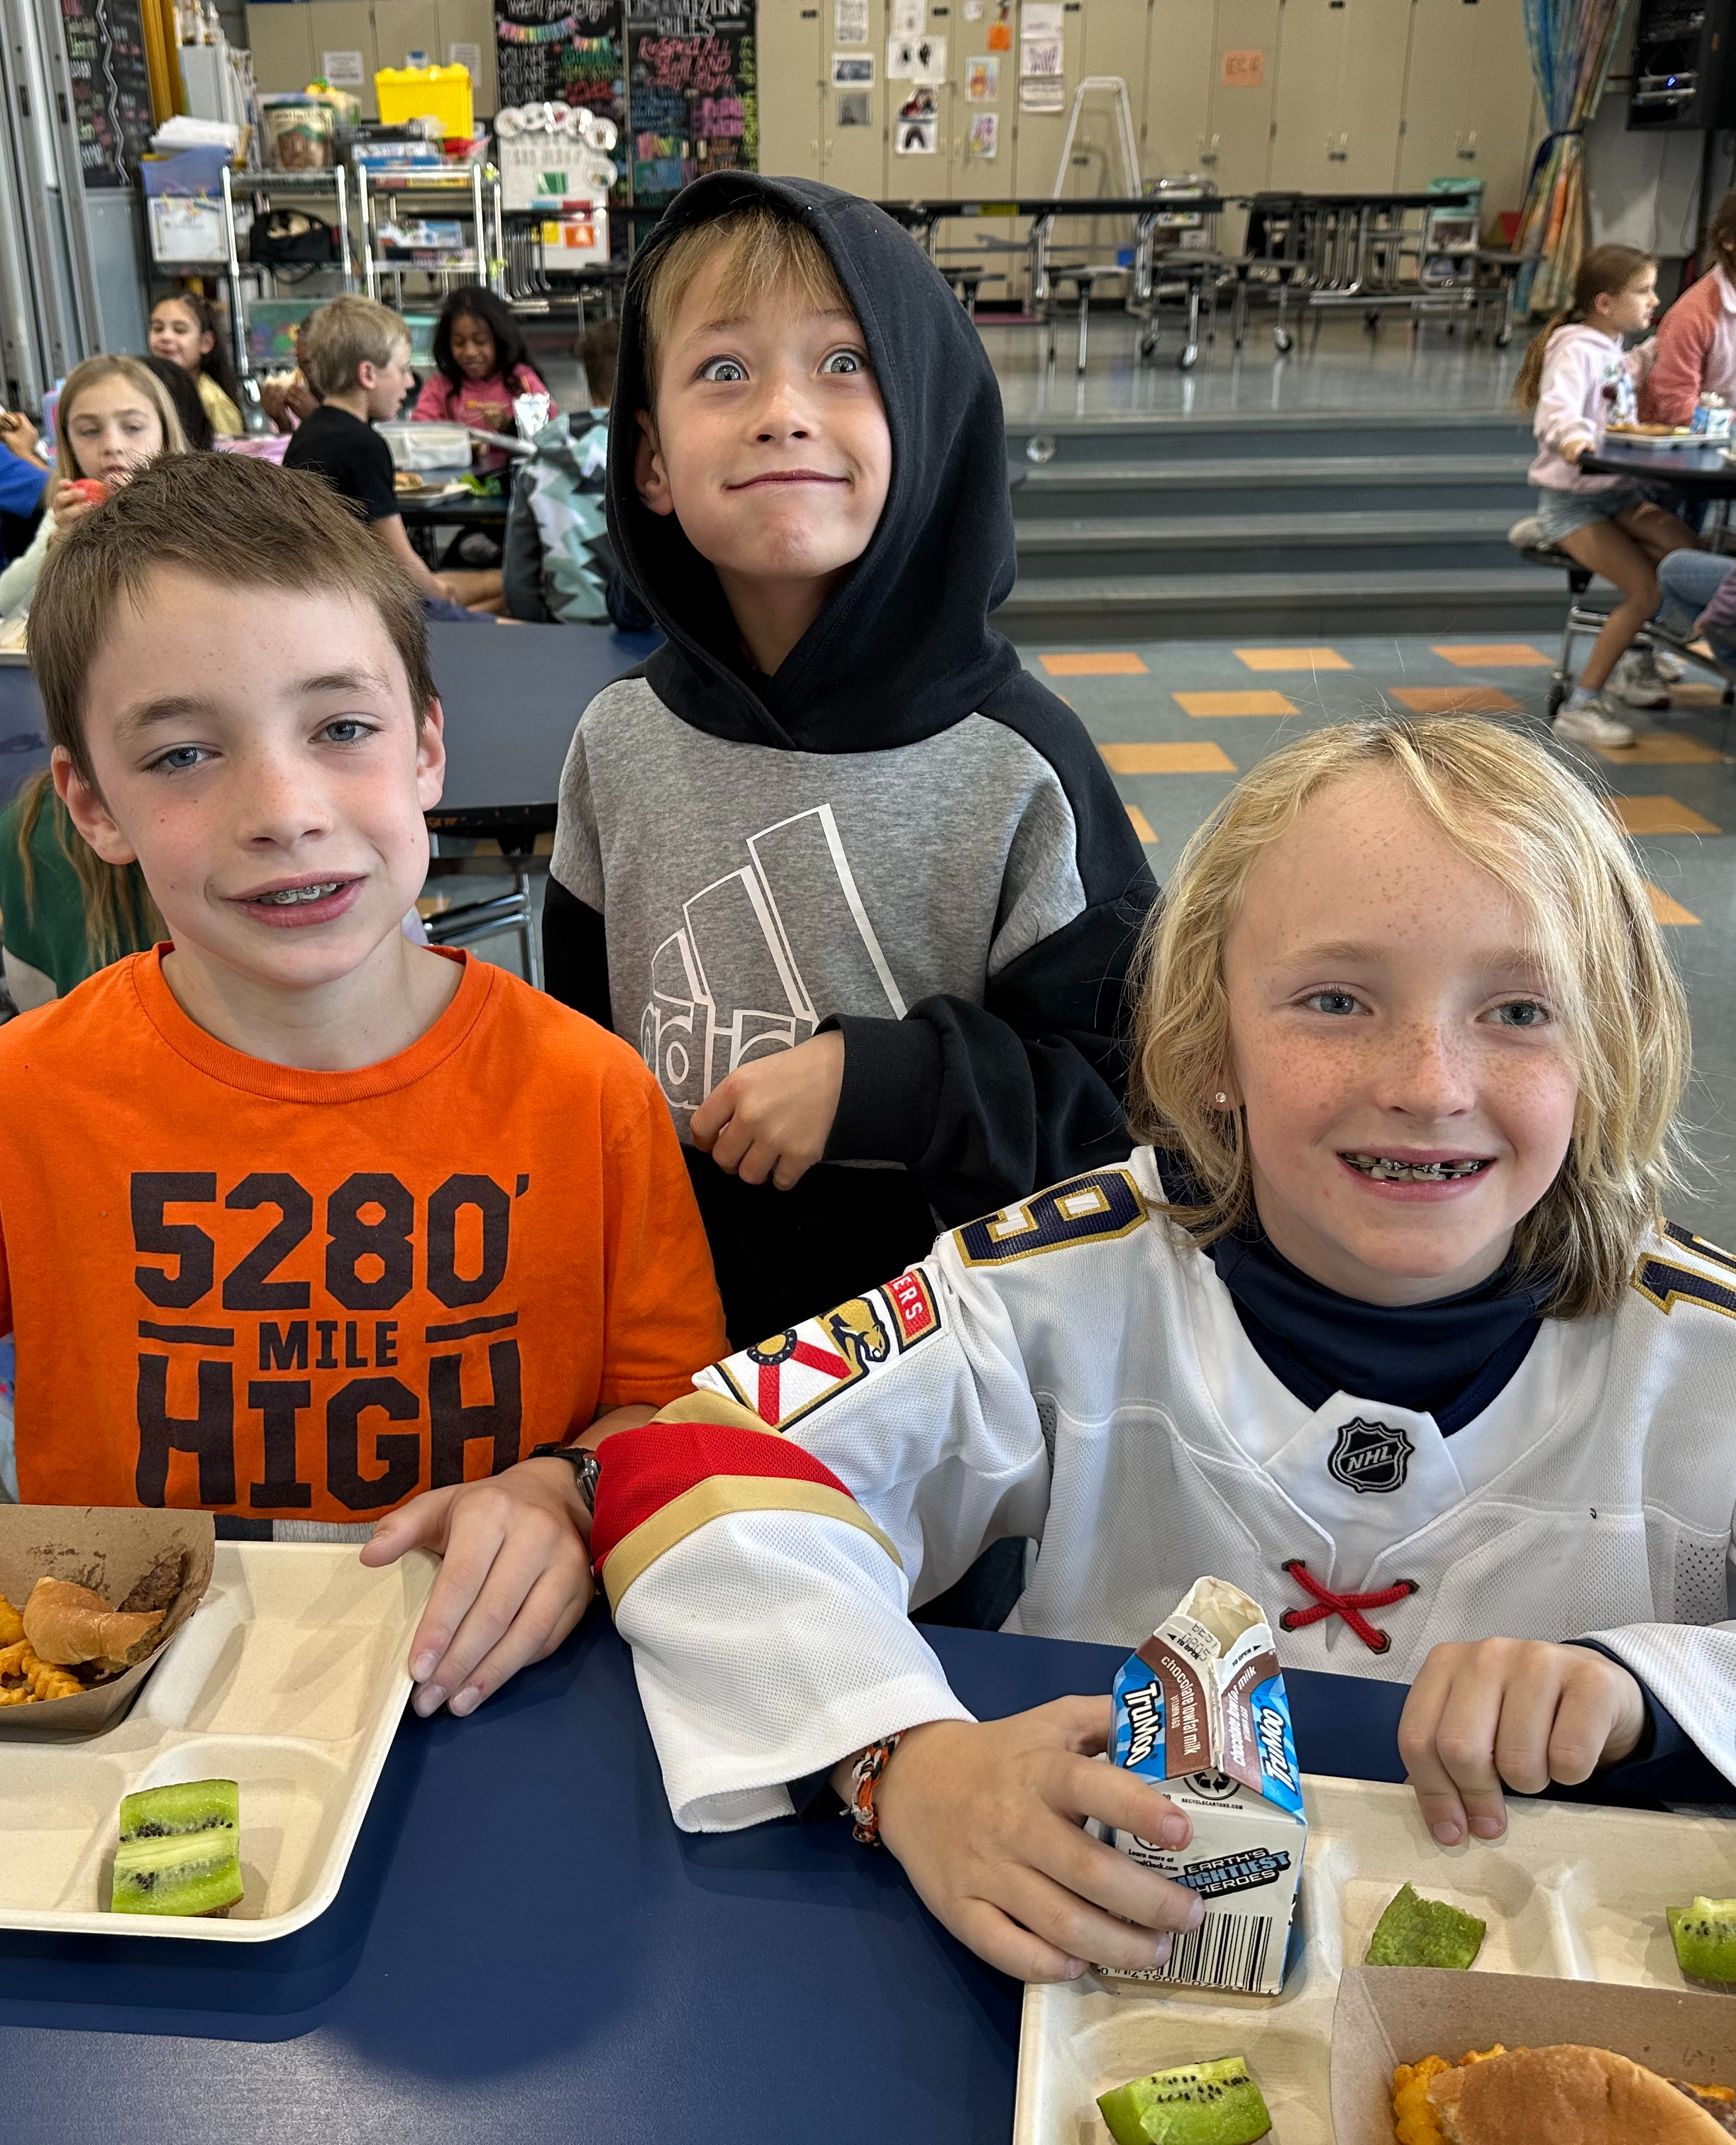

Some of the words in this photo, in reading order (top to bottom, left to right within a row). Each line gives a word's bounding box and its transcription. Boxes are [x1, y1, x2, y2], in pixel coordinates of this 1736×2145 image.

[657, 16, 715, 37] RULES
[131, 1172, 529, 1311] 5280'
[259, 1319, 398, 1370] MILE
[135, 1338, 523, 1511] HIGH
[1347, 1446, 1392, 1473] NHL
[1161, 1656, 1195, 1705] chocolate
[1237, 1665, 1256, 1690] milk
[1124, 1682, 1159, 1767] TruMoo
[1182, 1702, 1200, 1734] lowfat
[1183, 1734, 1202, 1756] milk
[1259, 1707, 1296, 1792] TruMoo
[1129, 1849, 1146, 1858] Learn
[1188, 1849, 1266, 1874] EARTH'S
